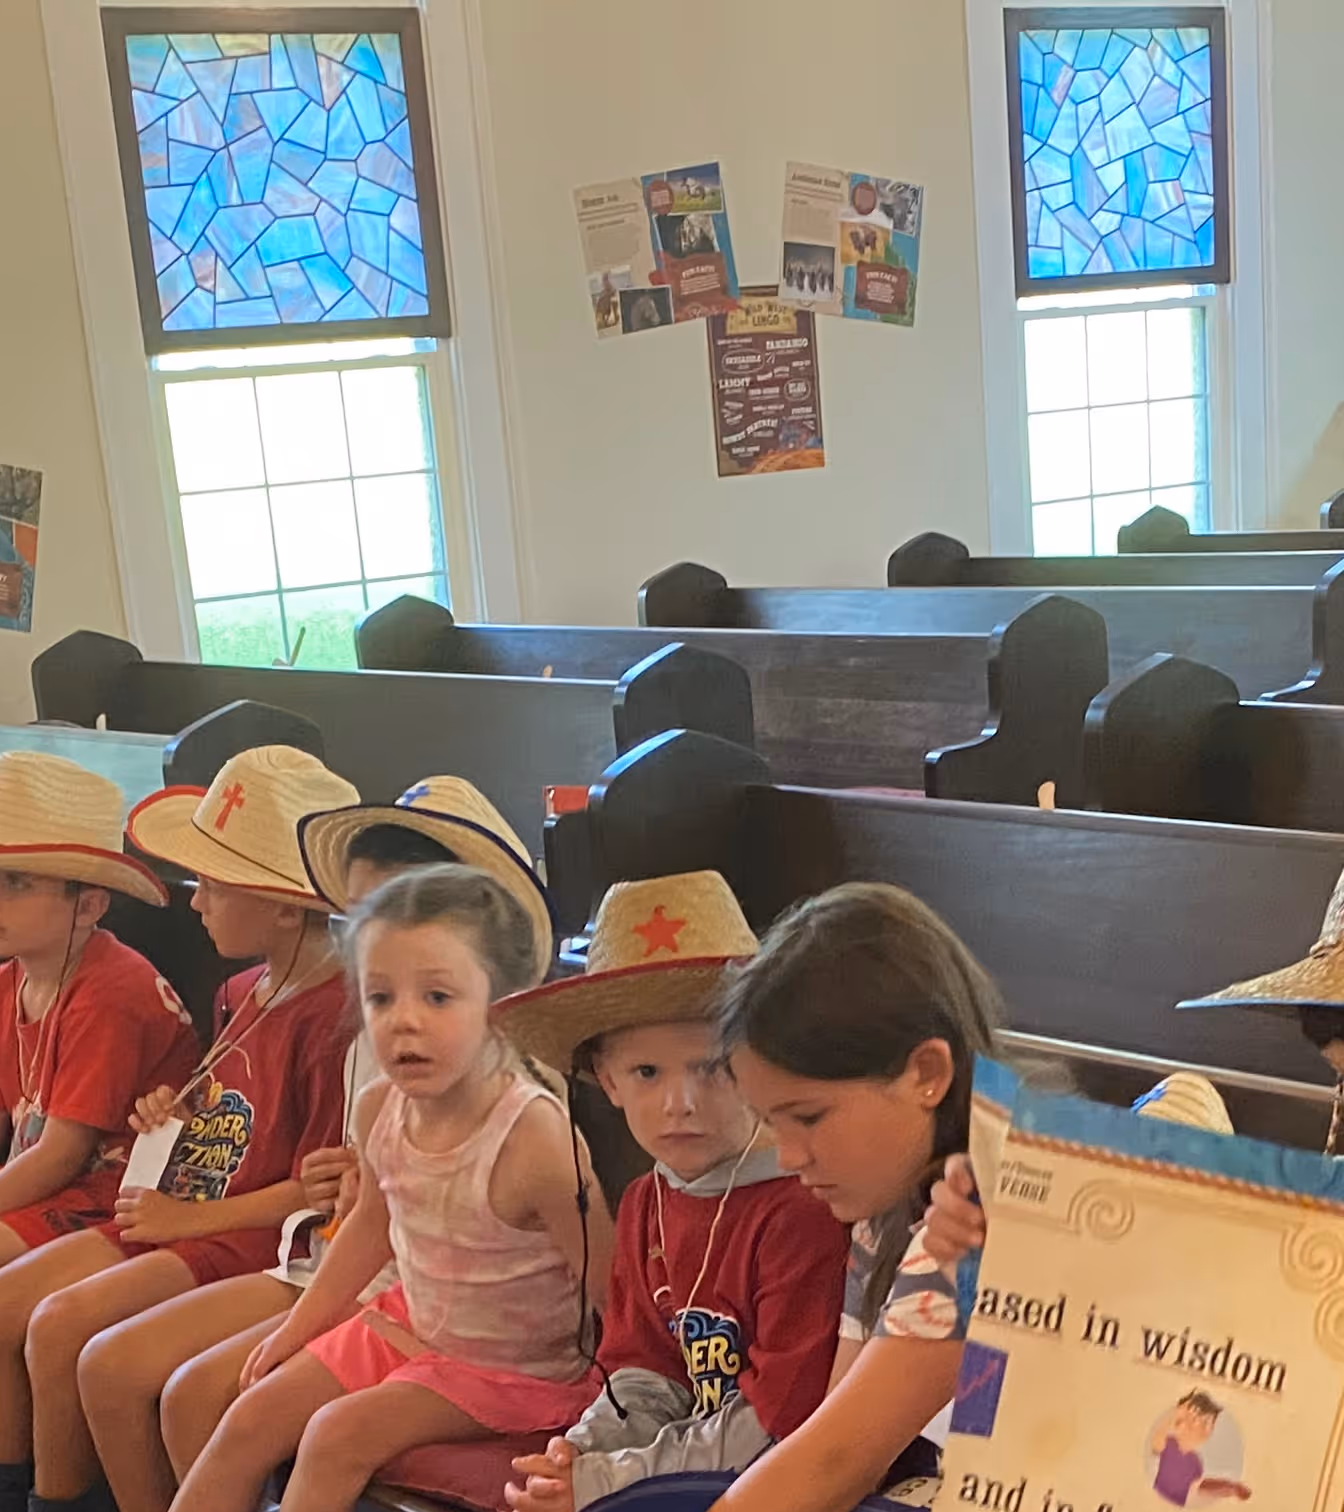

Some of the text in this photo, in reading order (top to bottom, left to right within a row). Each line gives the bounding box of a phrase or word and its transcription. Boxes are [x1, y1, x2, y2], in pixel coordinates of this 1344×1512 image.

[191, 1114, 247, 1146] ONDER
[1080, 1303, 1121, 1350] in
[1140, 1326, 1287, 1393] wisdom
